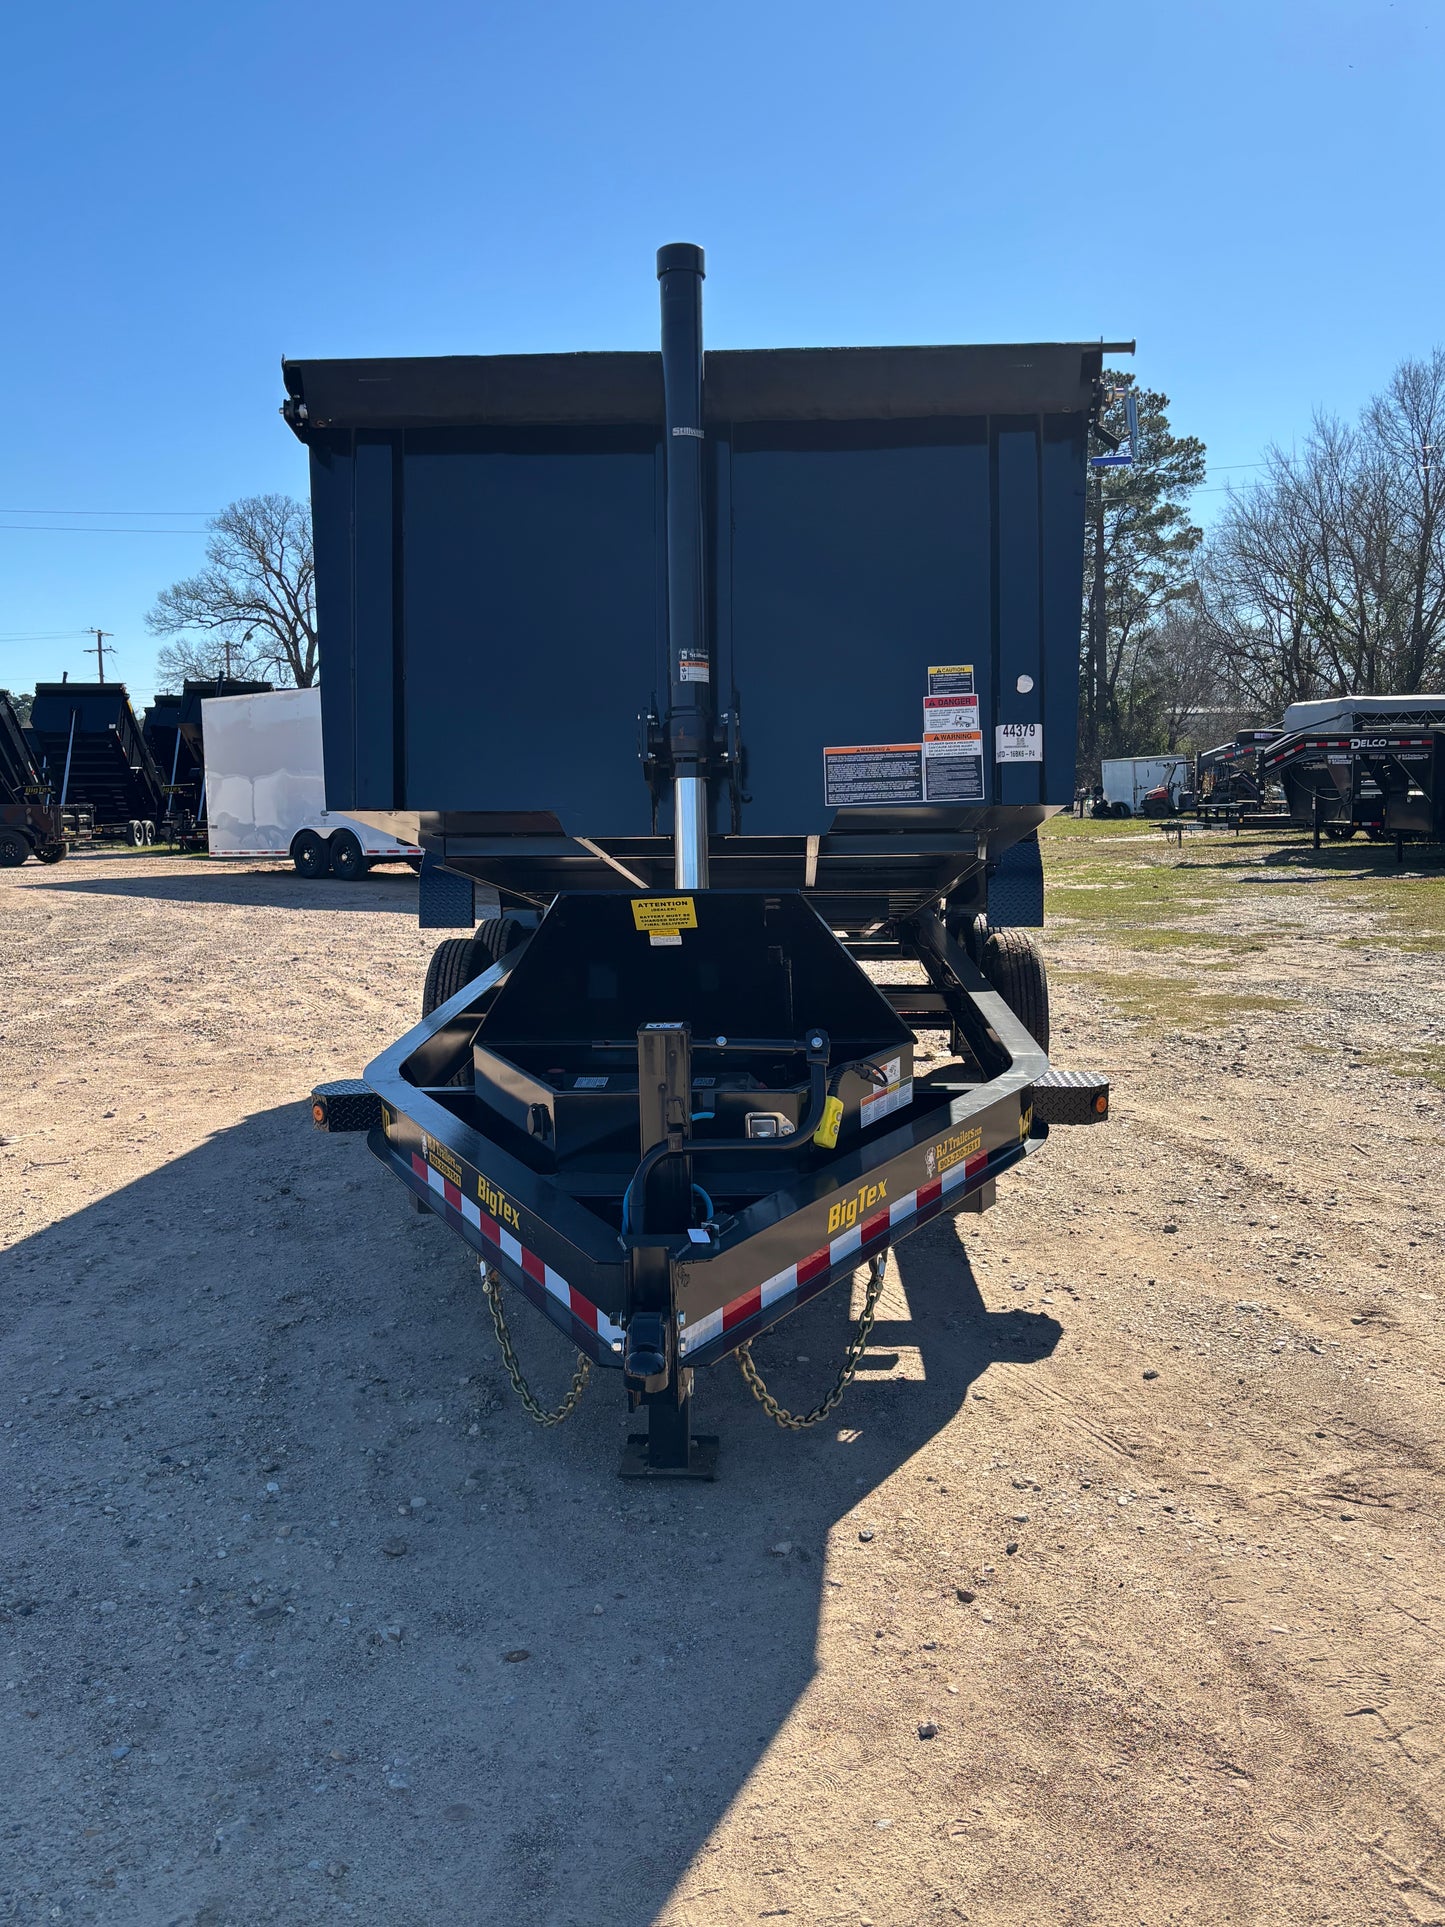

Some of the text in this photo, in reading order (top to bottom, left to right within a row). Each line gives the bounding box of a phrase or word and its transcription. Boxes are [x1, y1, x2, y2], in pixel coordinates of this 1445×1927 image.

[938, 697, 971, 706] DANGER
[940, 733, 972, 741] WARNING
[1003, 724, 1036, 737] 44379
[1349, 738, 1387, 750] DELCO
[935, 1140, 948, 1159] RJ
[477, 1174, 520, 1231] BigTex
[827, 1178, 888, 1235] BigTex
